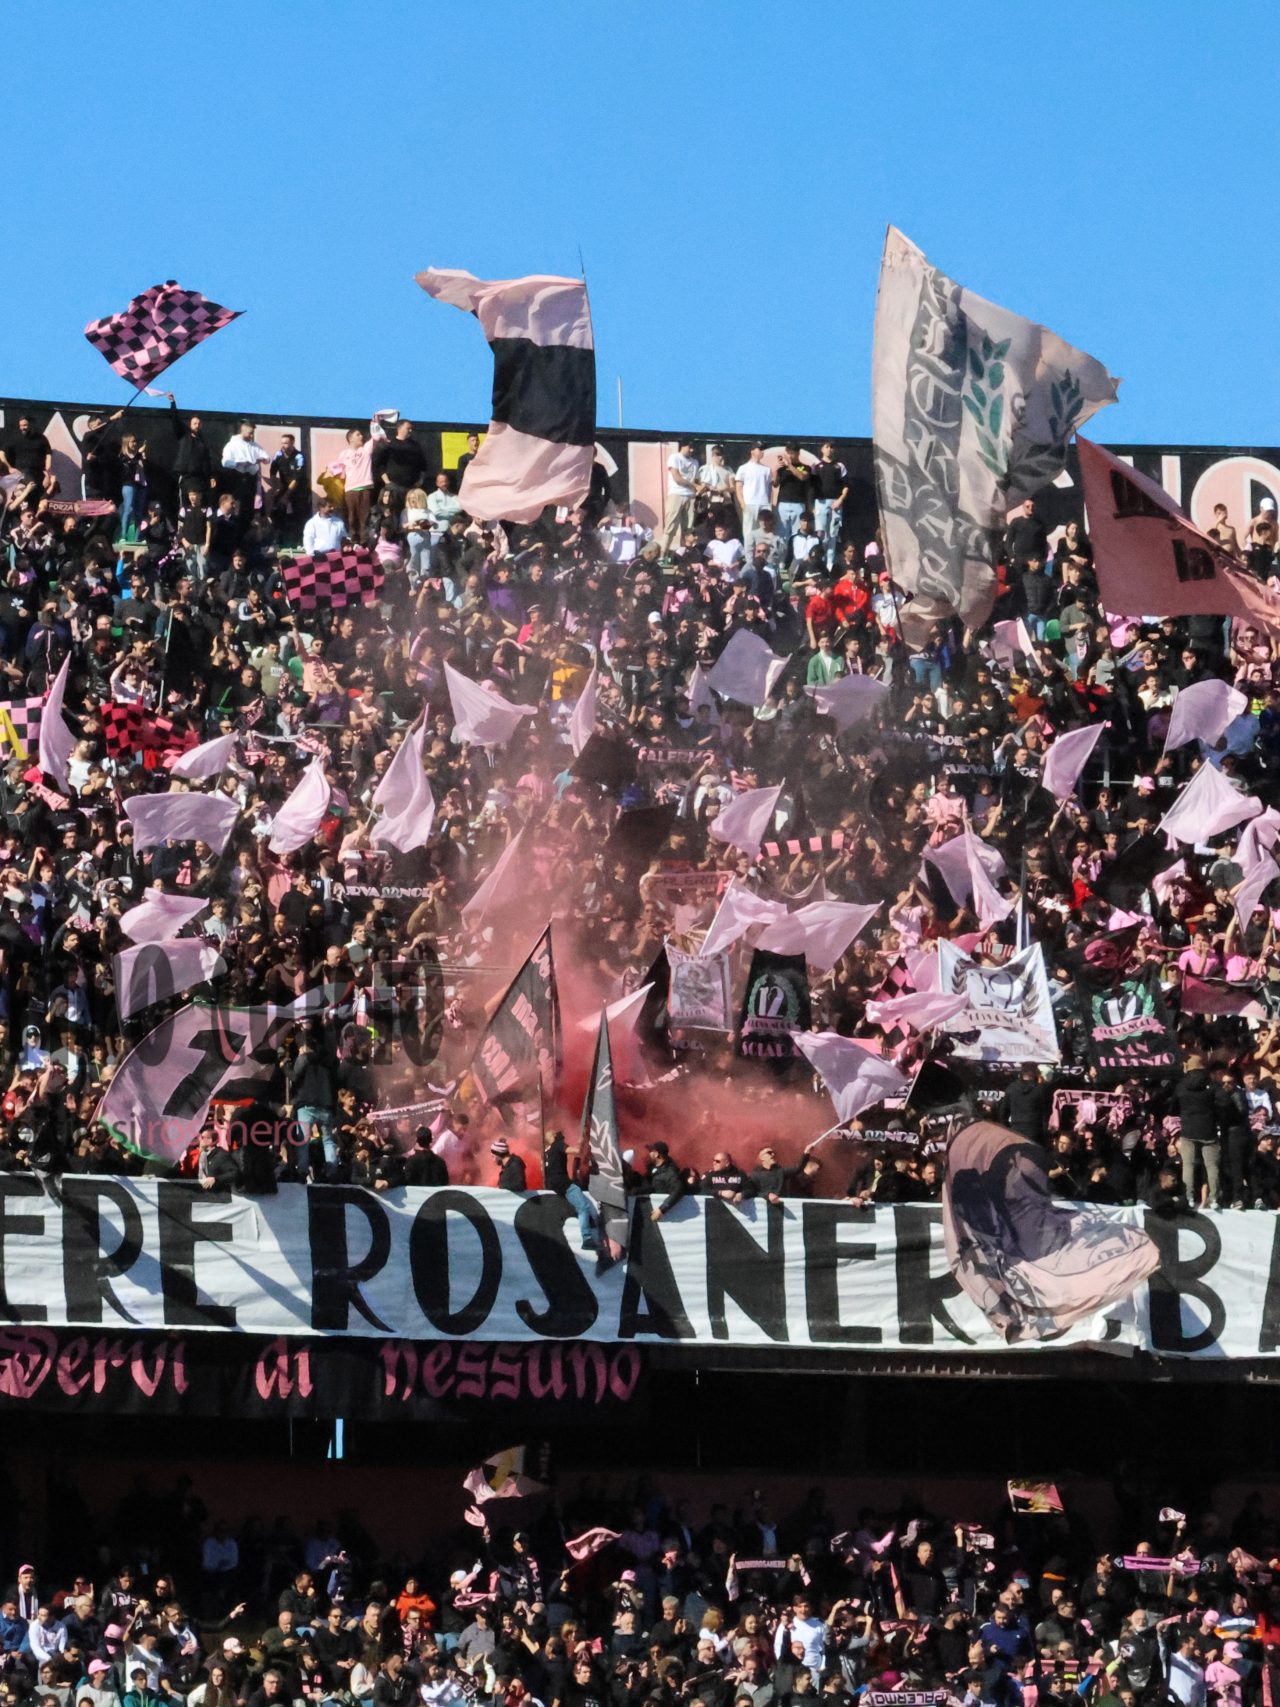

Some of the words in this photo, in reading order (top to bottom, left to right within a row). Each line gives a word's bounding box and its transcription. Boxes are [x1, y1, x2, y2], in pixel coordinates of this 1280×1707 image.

[48, 502, 74, 512] FORZA
[758, 985, 784, 1017] 12
[1103, 991, 1142, 1026] 12
[255, 1335, 314, 1400] di
[874, 1691, 945, 1705] PALERMO
